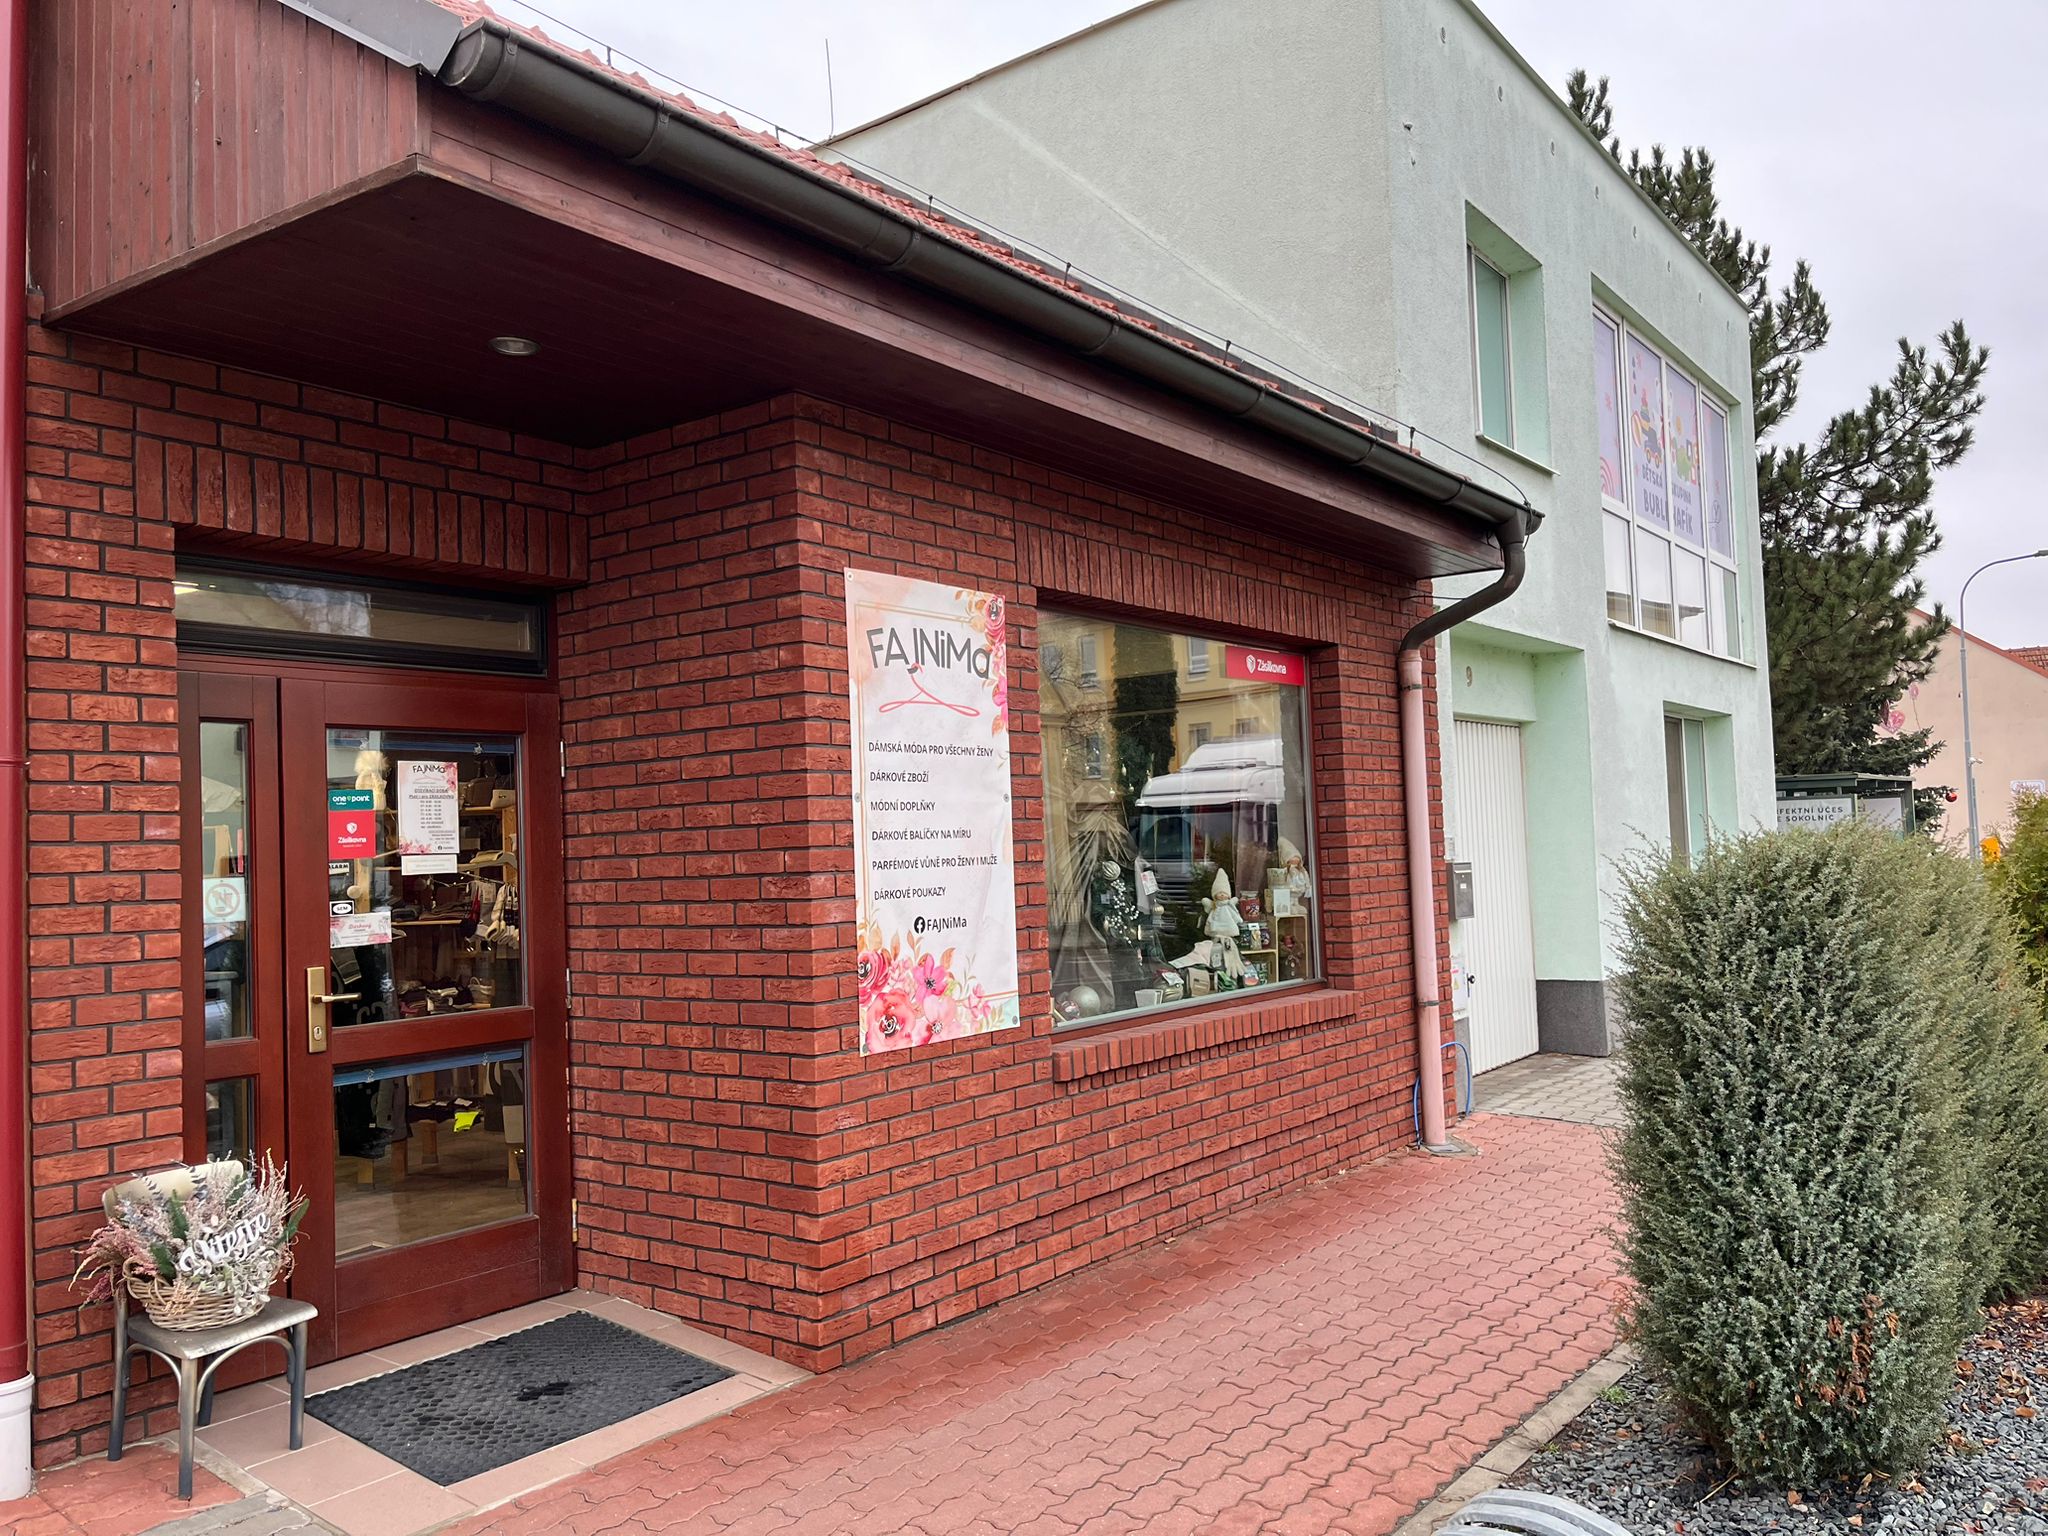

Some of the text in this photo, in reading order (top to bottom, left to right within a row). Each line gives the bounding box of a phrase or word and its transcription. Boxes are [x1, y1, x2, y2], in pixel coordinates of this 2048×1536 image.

[1465, 665, 1473, 688] 9
[868, 740, 994, 757] DÁMSKÁ MÓDA PRO VŠECHNY ŽENY
[870, 769, 929, 783] DÁRKOVÉ ZBOŽÍ
[870, 799, 936, 812] MÓDNÍ DOPLŇKY
[871, 827, 972, 841] DÁRKOVÉ BALÍČKY NA MÍRU
[872, 856, 919, 870] PARFÉMOVÉ
[919, 855, 941, 868] VŮNĚ
[941, 857, 957, 867] PRO
[957, 855, 975, 867] ŽENY
[980, 854, 998, 865] MUŽE
[874, 886, 947, 900] DÁRKOVÉ POUKAZY
[926, 917, 968, 932] FAJNiMa
